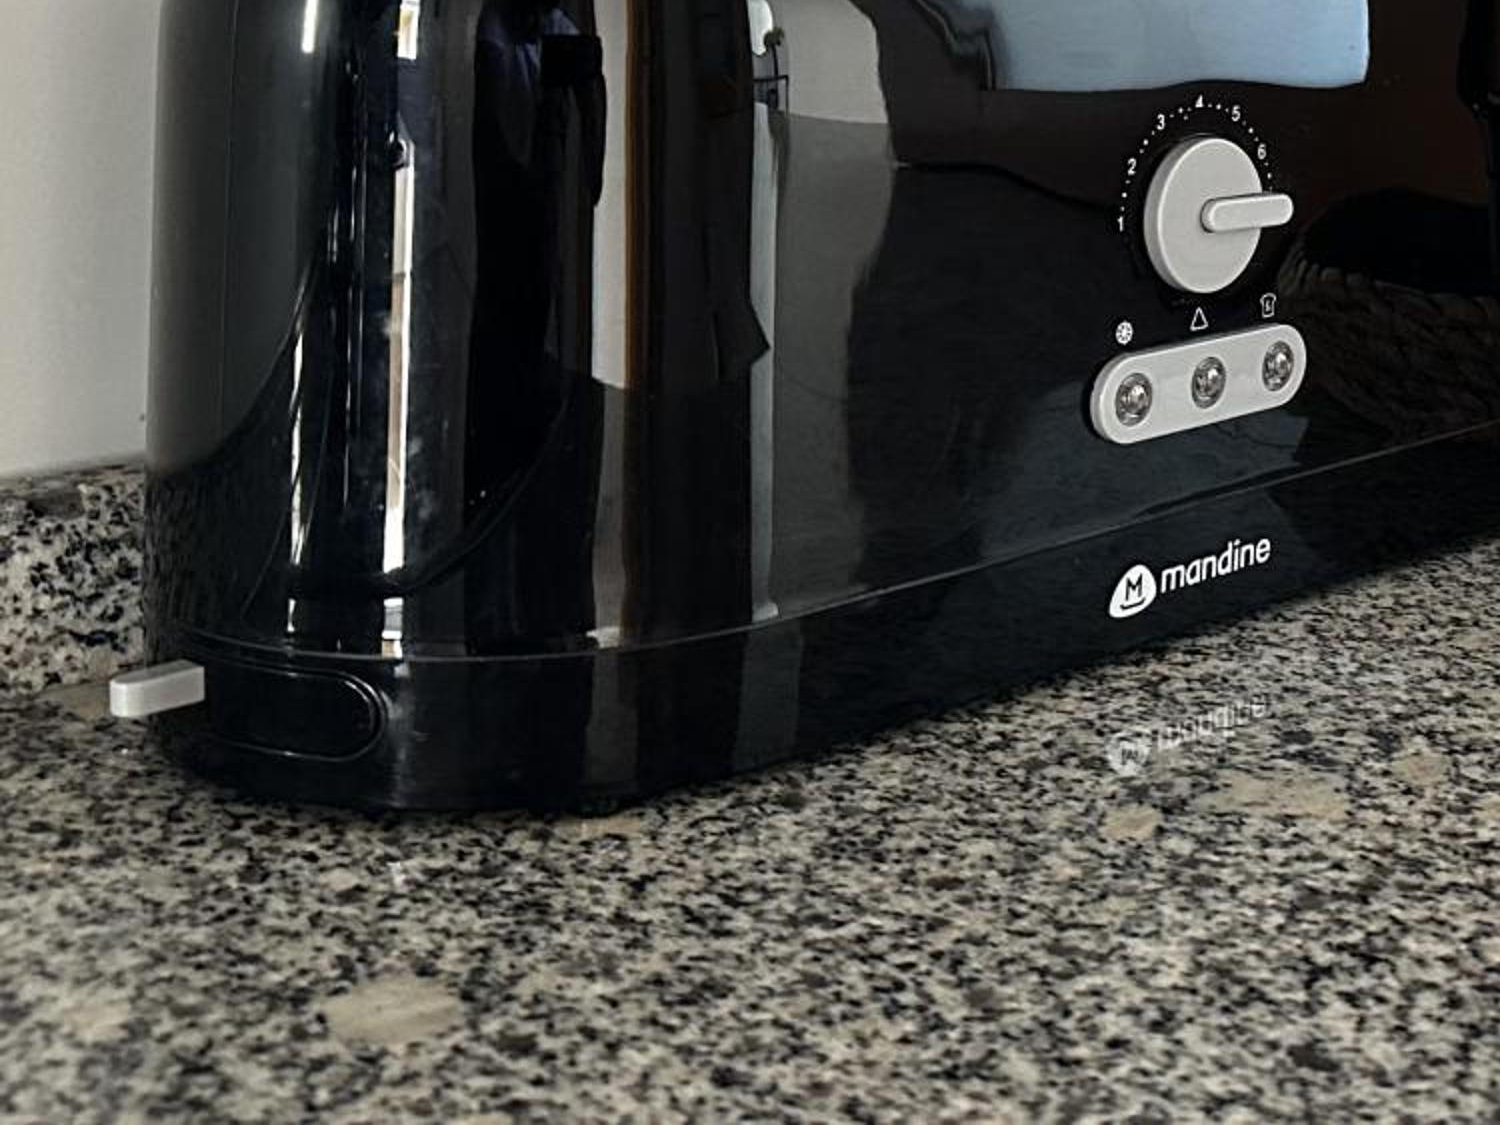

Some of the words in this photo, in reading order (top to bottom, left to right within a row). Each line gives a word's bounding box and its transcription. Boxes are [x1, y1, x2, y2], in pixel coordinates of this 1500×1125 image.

[1117, 215, 1124, 232] 1
[1127, 158, 1137, 175] 2
[1156, 114, 1166, 130] 3
[1195, 95, 1204, 108] 4
[1231, 105, 1241, 122] 5
[1257, 144, 1267, 160] 6
[1160, 538, 1271, 593] mandine
